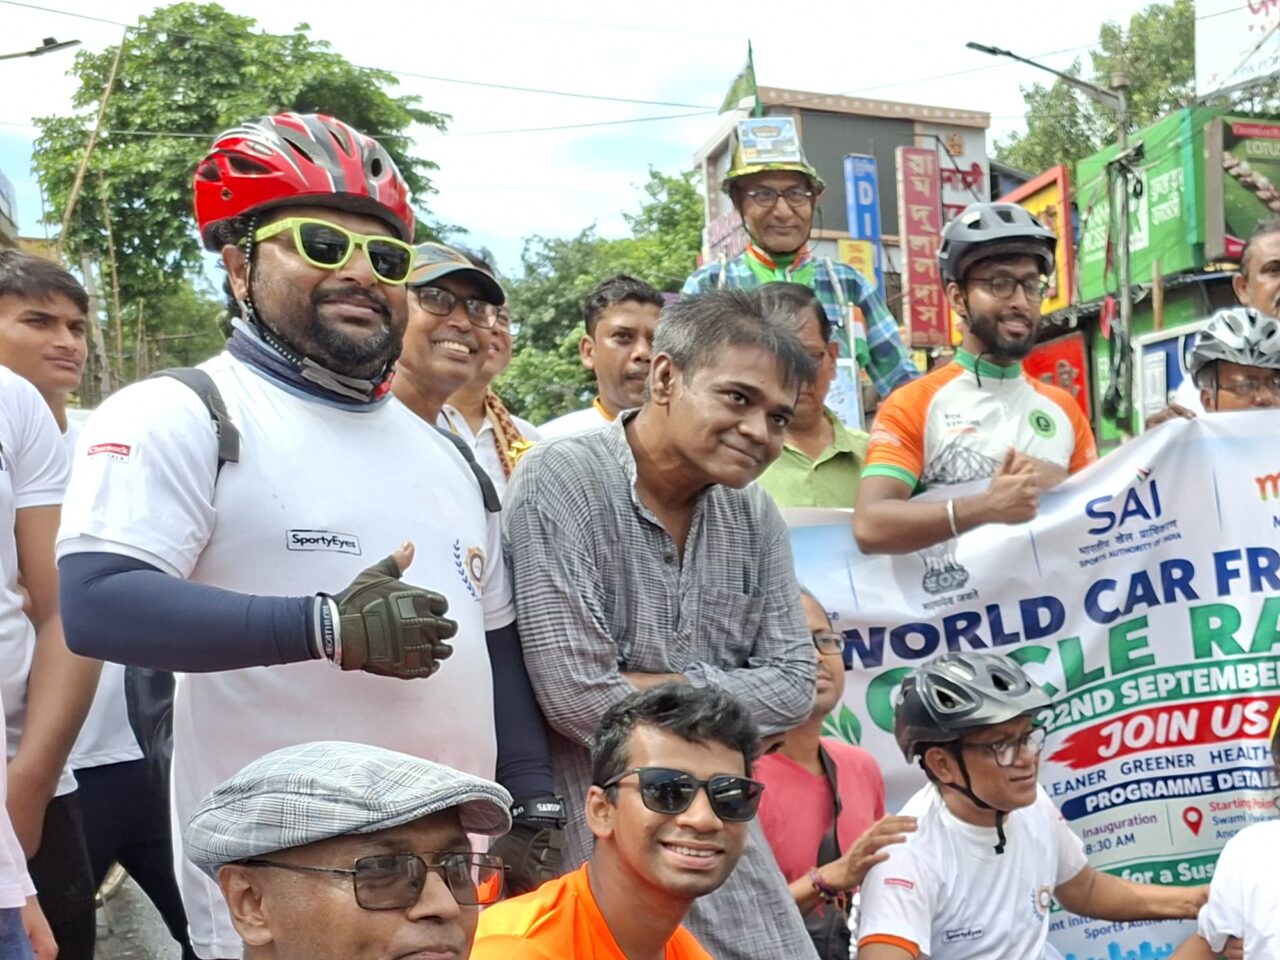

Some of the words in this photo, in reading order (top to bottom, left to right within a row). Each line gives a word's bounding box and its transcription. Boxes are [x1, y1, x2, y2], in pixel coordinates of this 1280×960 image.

[1085, 479, 1162, 536] SAI
[292, 533, 356, 548] SportyEyes
[1084, 558, 1201, 625] CAR
[866, 614, 1156, 734] CCLE
[1038, 687, 1115, 729] 22ND
[1097, 709, 1200, 758] JOIN
[1211, 701, 1271, 738] US
[1048, 769, 1107, 798] LEANER
[1120, 753, 1195, 776] GREENER
[1209, 746, 1272, 764] HEALTH
[1085, 773, 1214, 813] PROGRAMME
[1217, 769, 1280, 790] DETAIL
[1209, 797, 1251, 812] Starting
[1082, 812, 1158, 839] Inauguration
[1212, 812, 1246, 826] Swami
[1085, 839, 1112, 856] 8:30
[1115, 833, 1136, 847] AM
[1159, 869, 1174, 884] a
[1084, 921, 1124, 939] Sports
